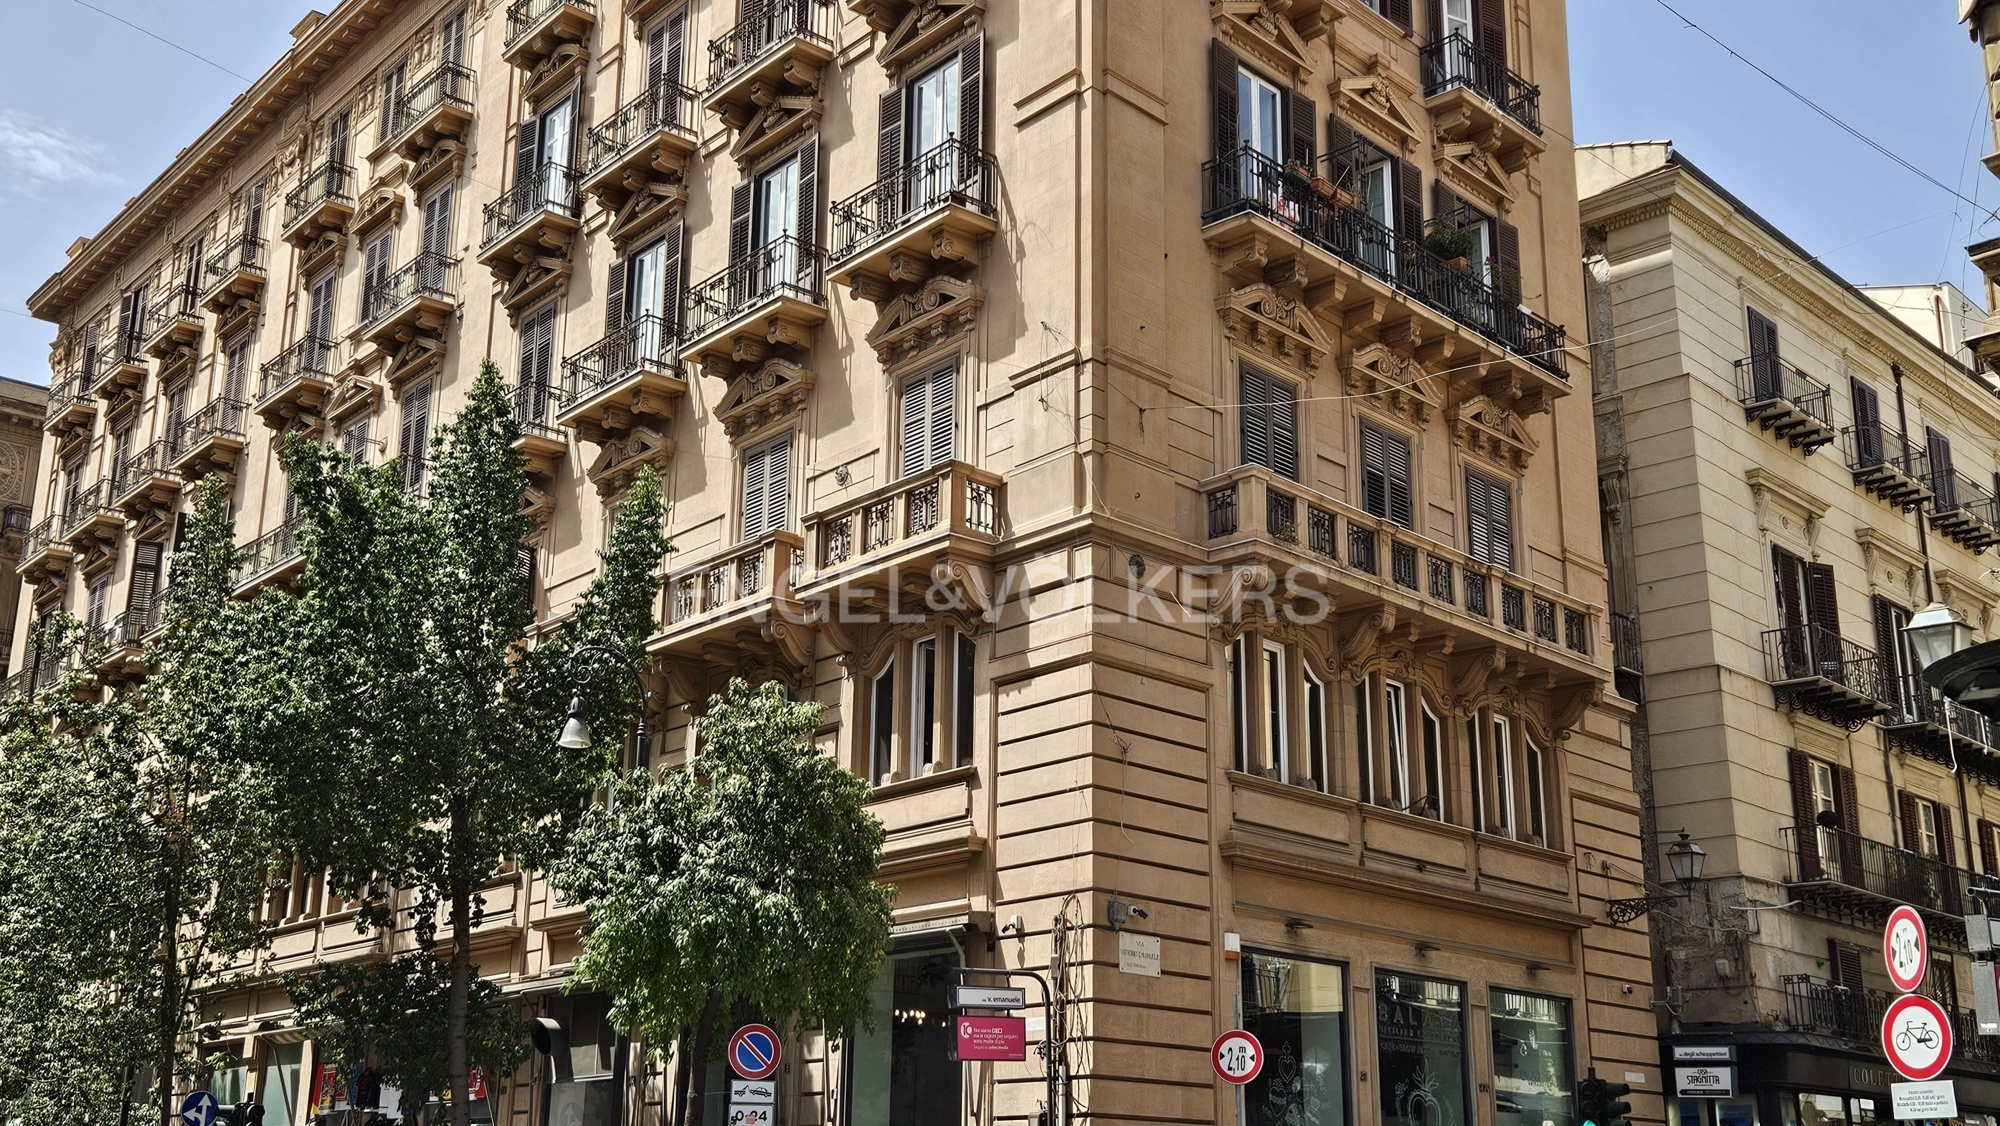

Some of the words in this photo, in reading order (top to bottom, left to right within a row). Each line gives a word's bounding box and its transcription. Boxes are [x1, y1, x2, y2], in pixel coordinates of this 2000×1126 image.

[1135, 940, 1144, 948] VIA
[1138, 951, 1159, 961] EMANUELE
[1896, 931, 1914, 974] 2,10
[1238, 1046, 1247, 1054] m
[1227, 1046, 1246, 1075] 2,10
[1686, 1075, 1720, 1086] STAGNITTA
[1853, 1067, 1905, 1087] COLETT
